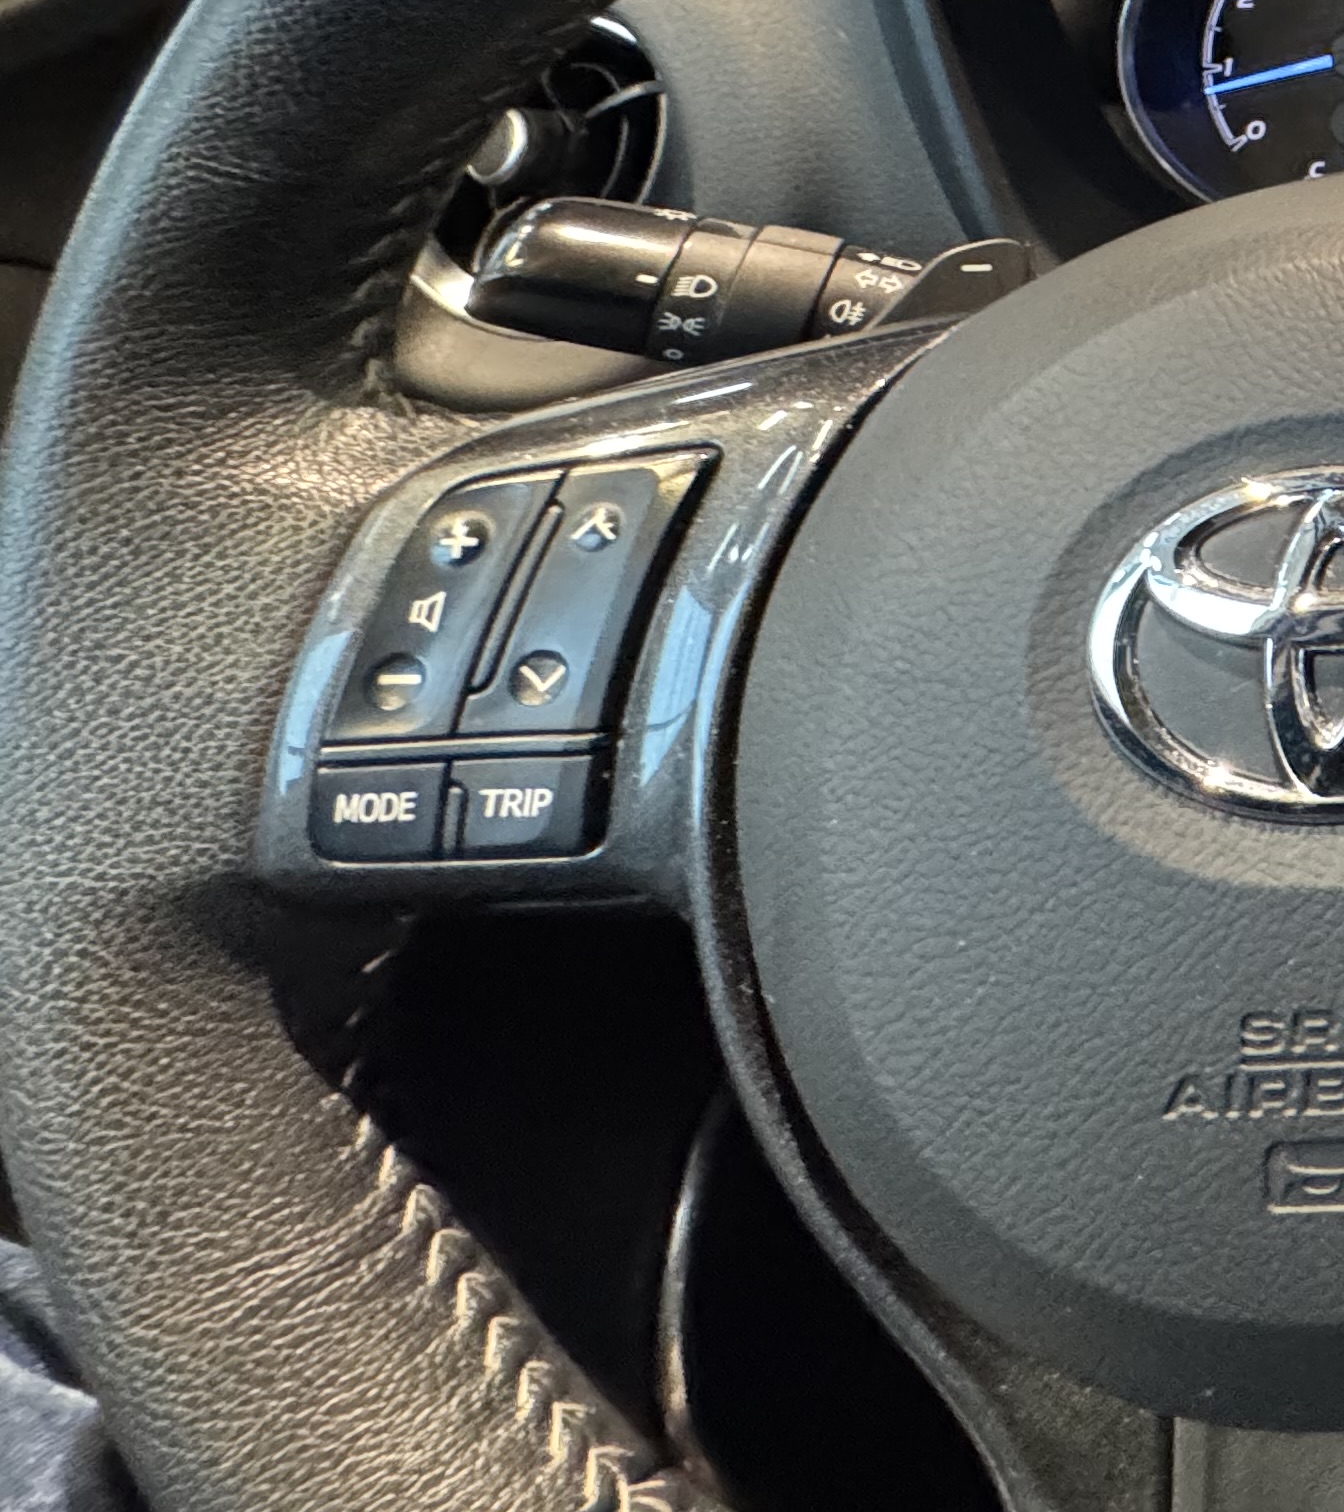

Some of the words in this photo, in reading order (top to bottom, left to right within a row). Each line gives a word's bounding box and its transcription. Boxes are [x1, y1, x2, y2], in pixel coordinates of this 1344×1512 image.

[1223, 57, 1234, 77] 1
[1246, 120, 1267, 140] 0
[333, 792, 418, 823] MODE
[479, 788, 553, 818] TRIP
